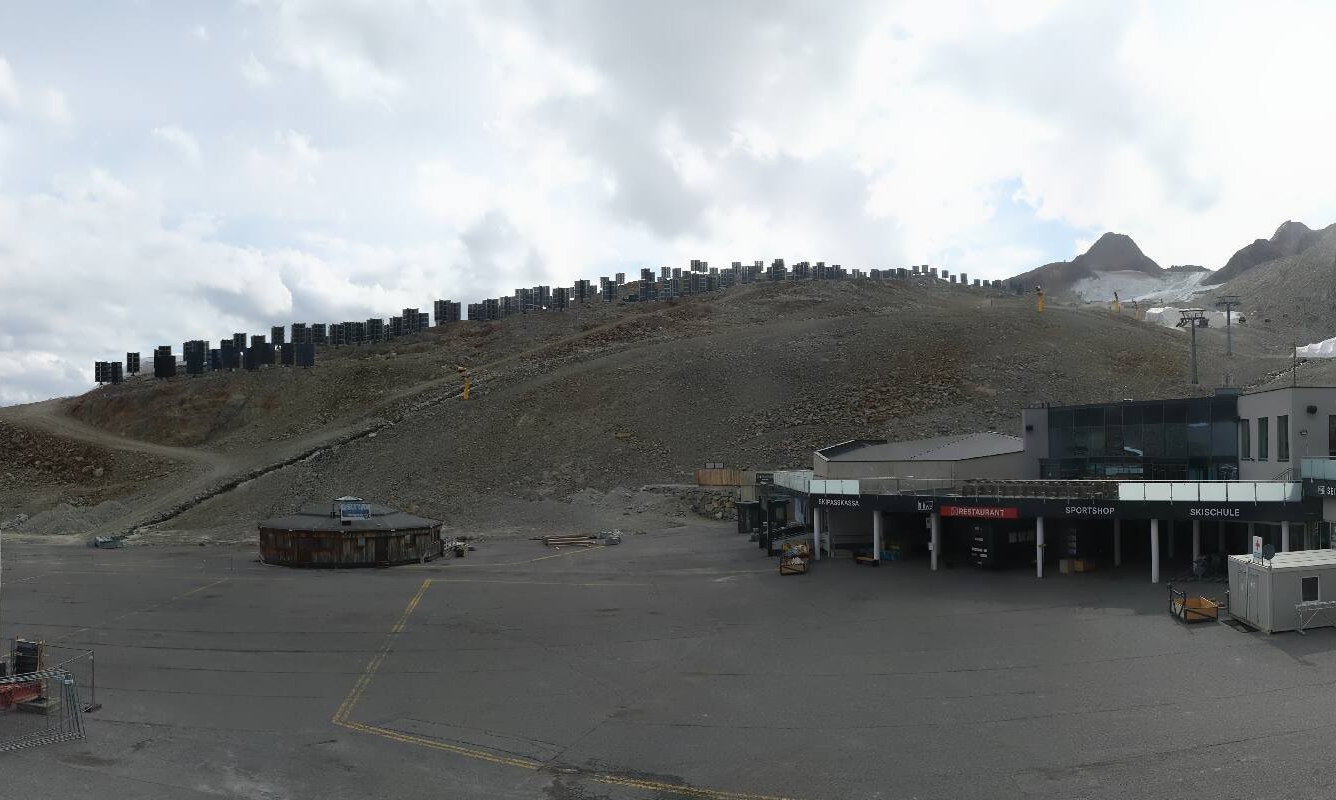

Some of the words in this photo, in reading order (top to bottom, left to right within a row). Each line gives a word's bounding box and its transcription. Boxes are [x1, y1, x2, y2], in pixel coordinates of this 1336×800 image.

[818, 498, 860, 507] SKIPASSKASSA
[958, 506, 1005, 517] RESTAURANT
[1065, 506, 1116, 515] SPORTSHOP
[1190, 508, 1240, 517] SKISCHULE
